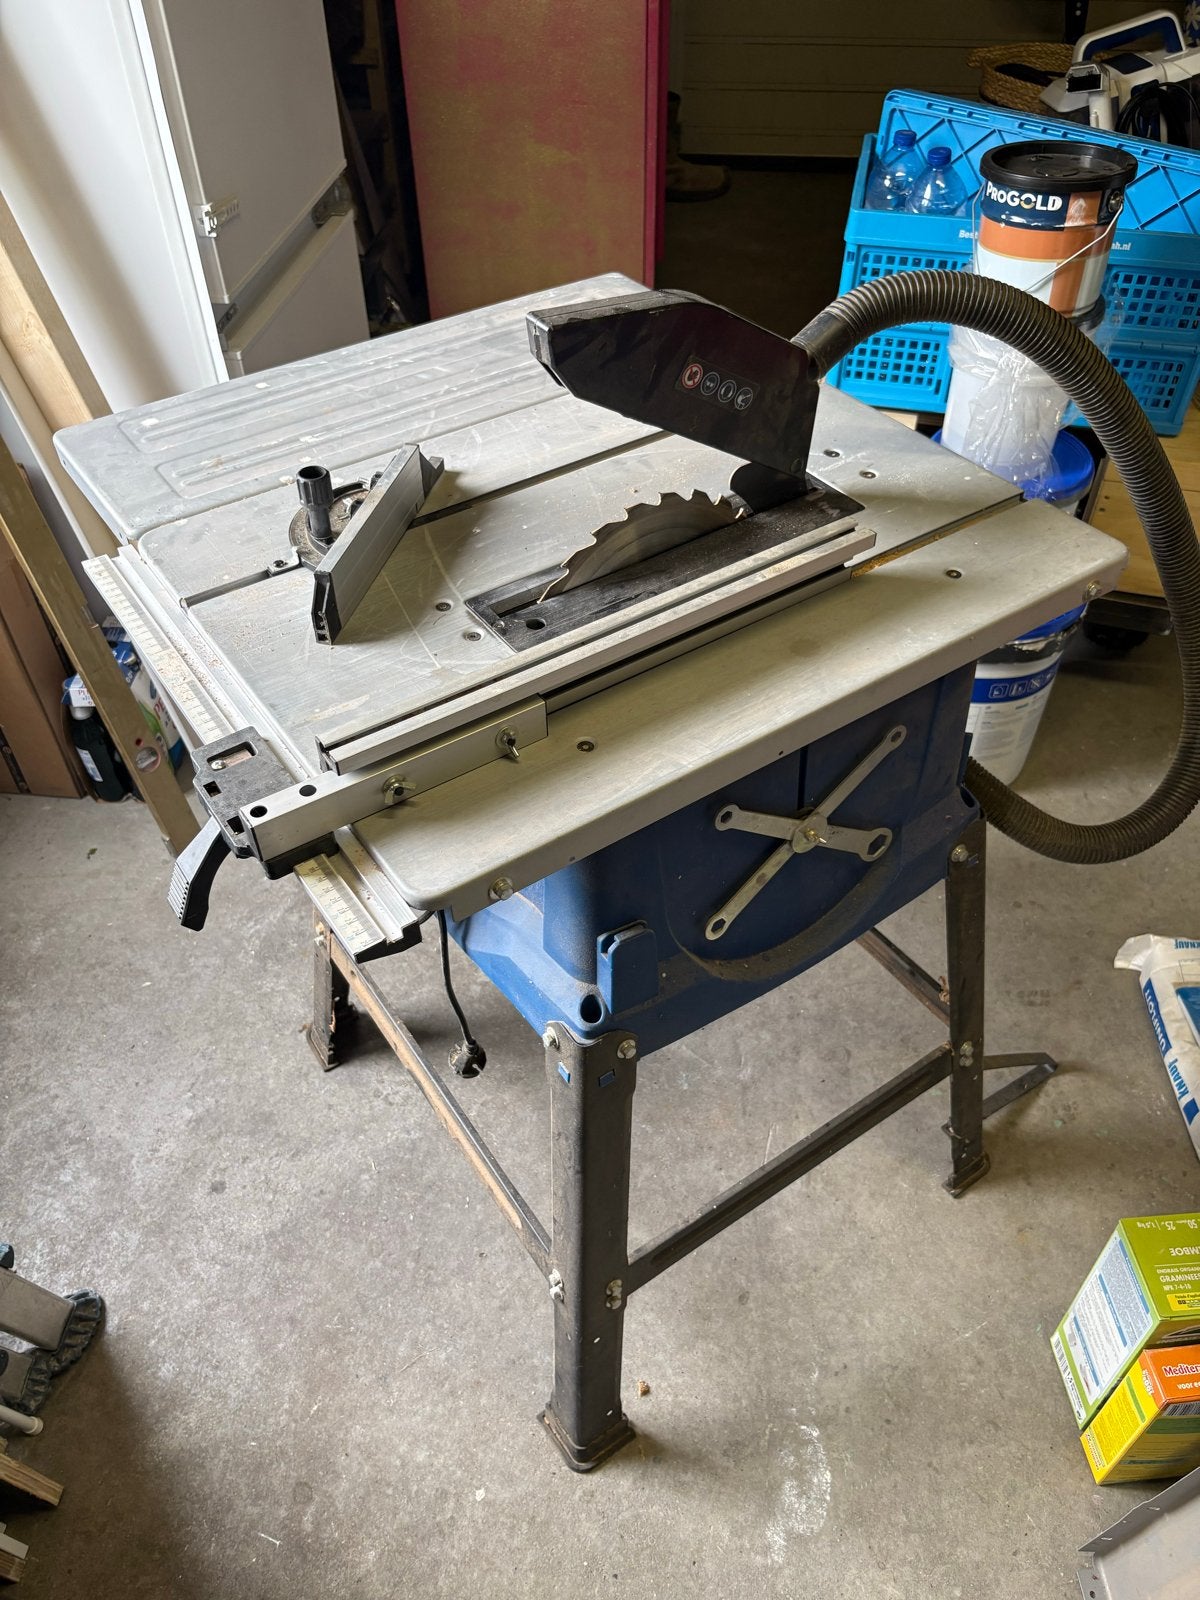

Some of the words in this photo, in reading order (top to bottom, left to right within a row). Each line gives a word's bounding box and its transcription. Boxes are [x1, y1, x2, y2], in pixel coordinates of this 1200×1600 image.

[1145, 988, 1167, 1052] UNIFLOTT
[1168, 1058, 1190, 1101] KNAUF
[1169, 1245, 1200, 1256] MBOE
[1162, 1364, 1200, 1378] Mediter
